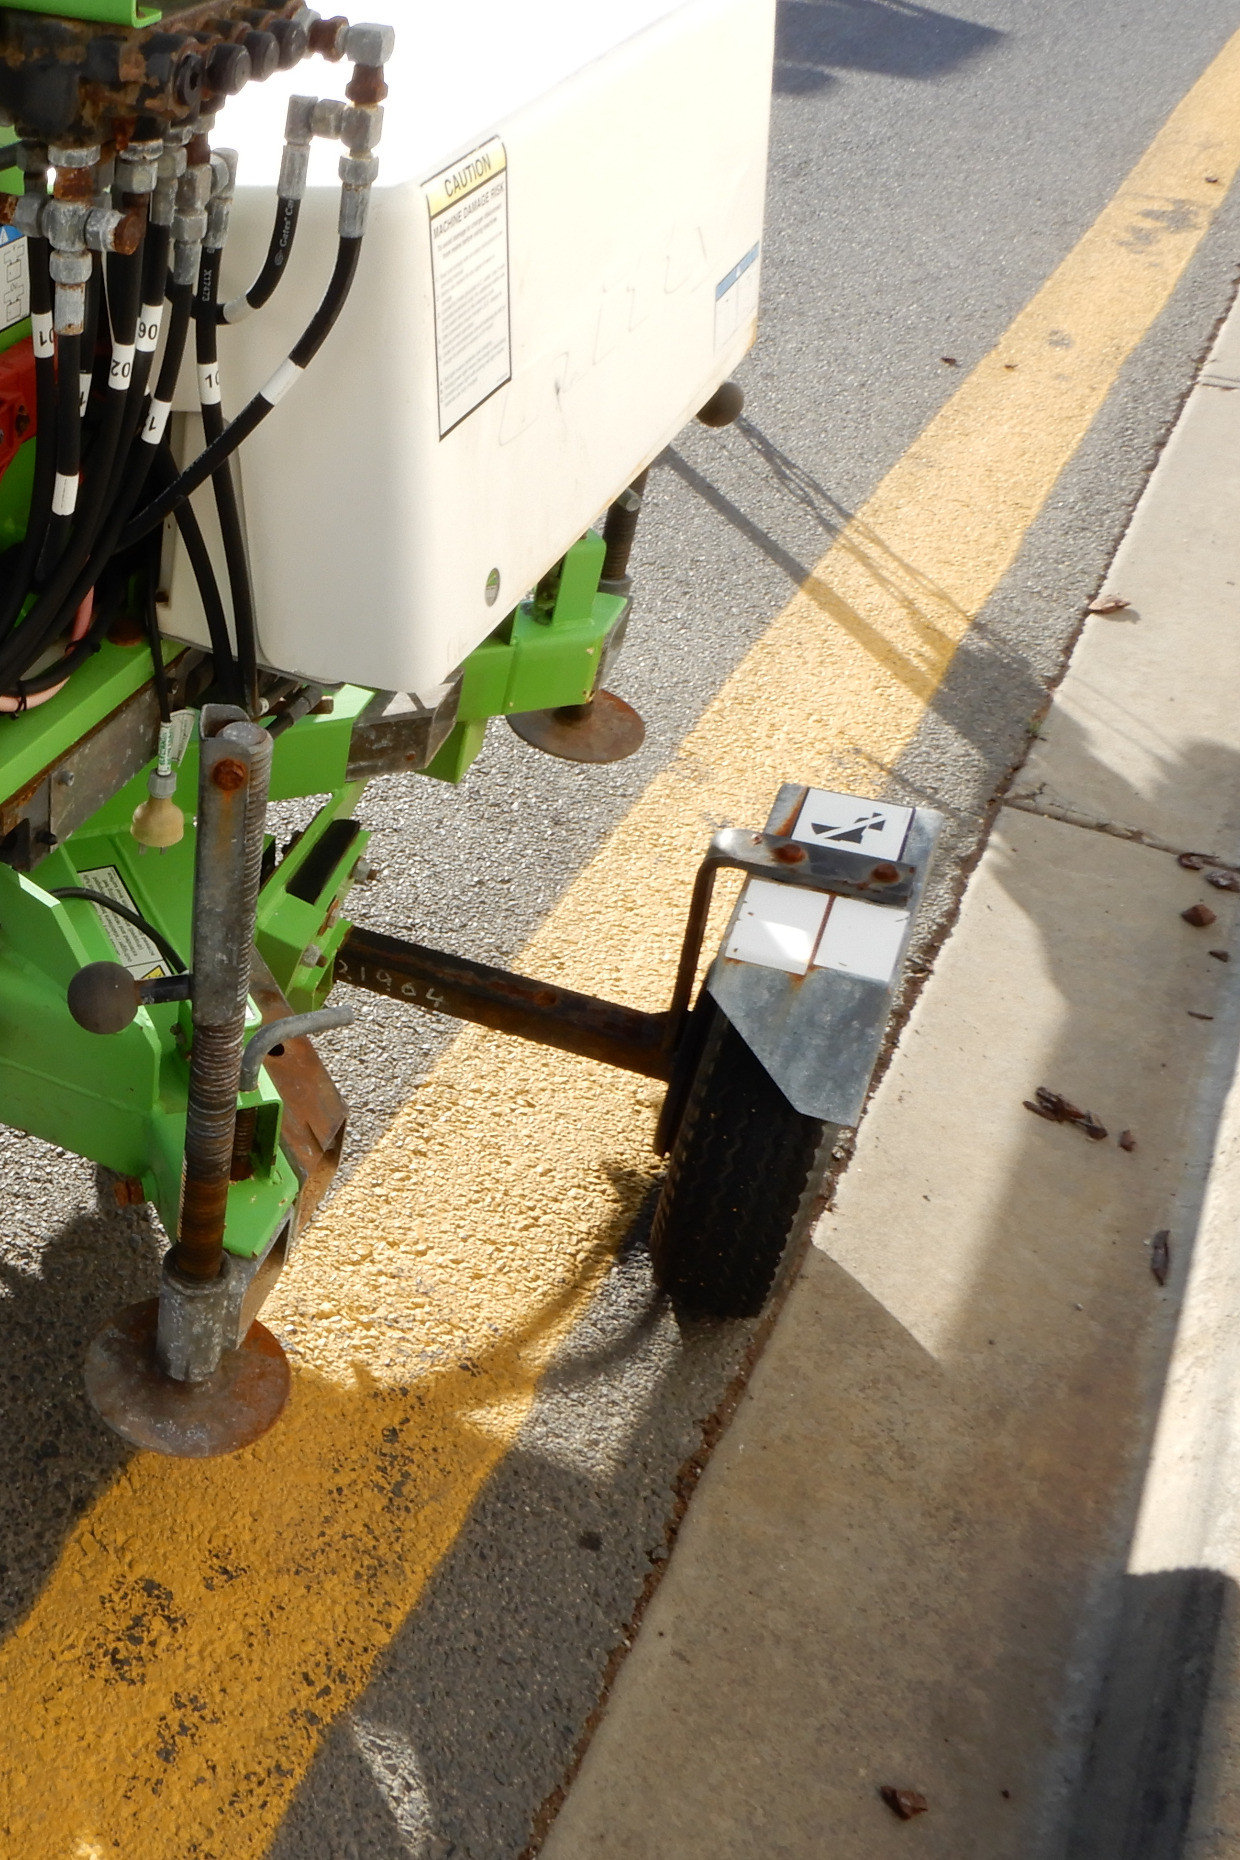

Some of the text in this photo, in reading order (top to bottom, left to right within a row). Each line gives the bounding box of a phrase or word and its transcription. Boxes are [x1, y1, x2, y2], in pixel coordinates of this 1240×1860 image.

[444, 153, 491, 198] CAUTION
[434, 210, 462, 239] MACHINE
[463, 191, 490, 219] DAMAGE
[490, 181, 505, 199] RISK
[111, 358, 131, 379] 02
